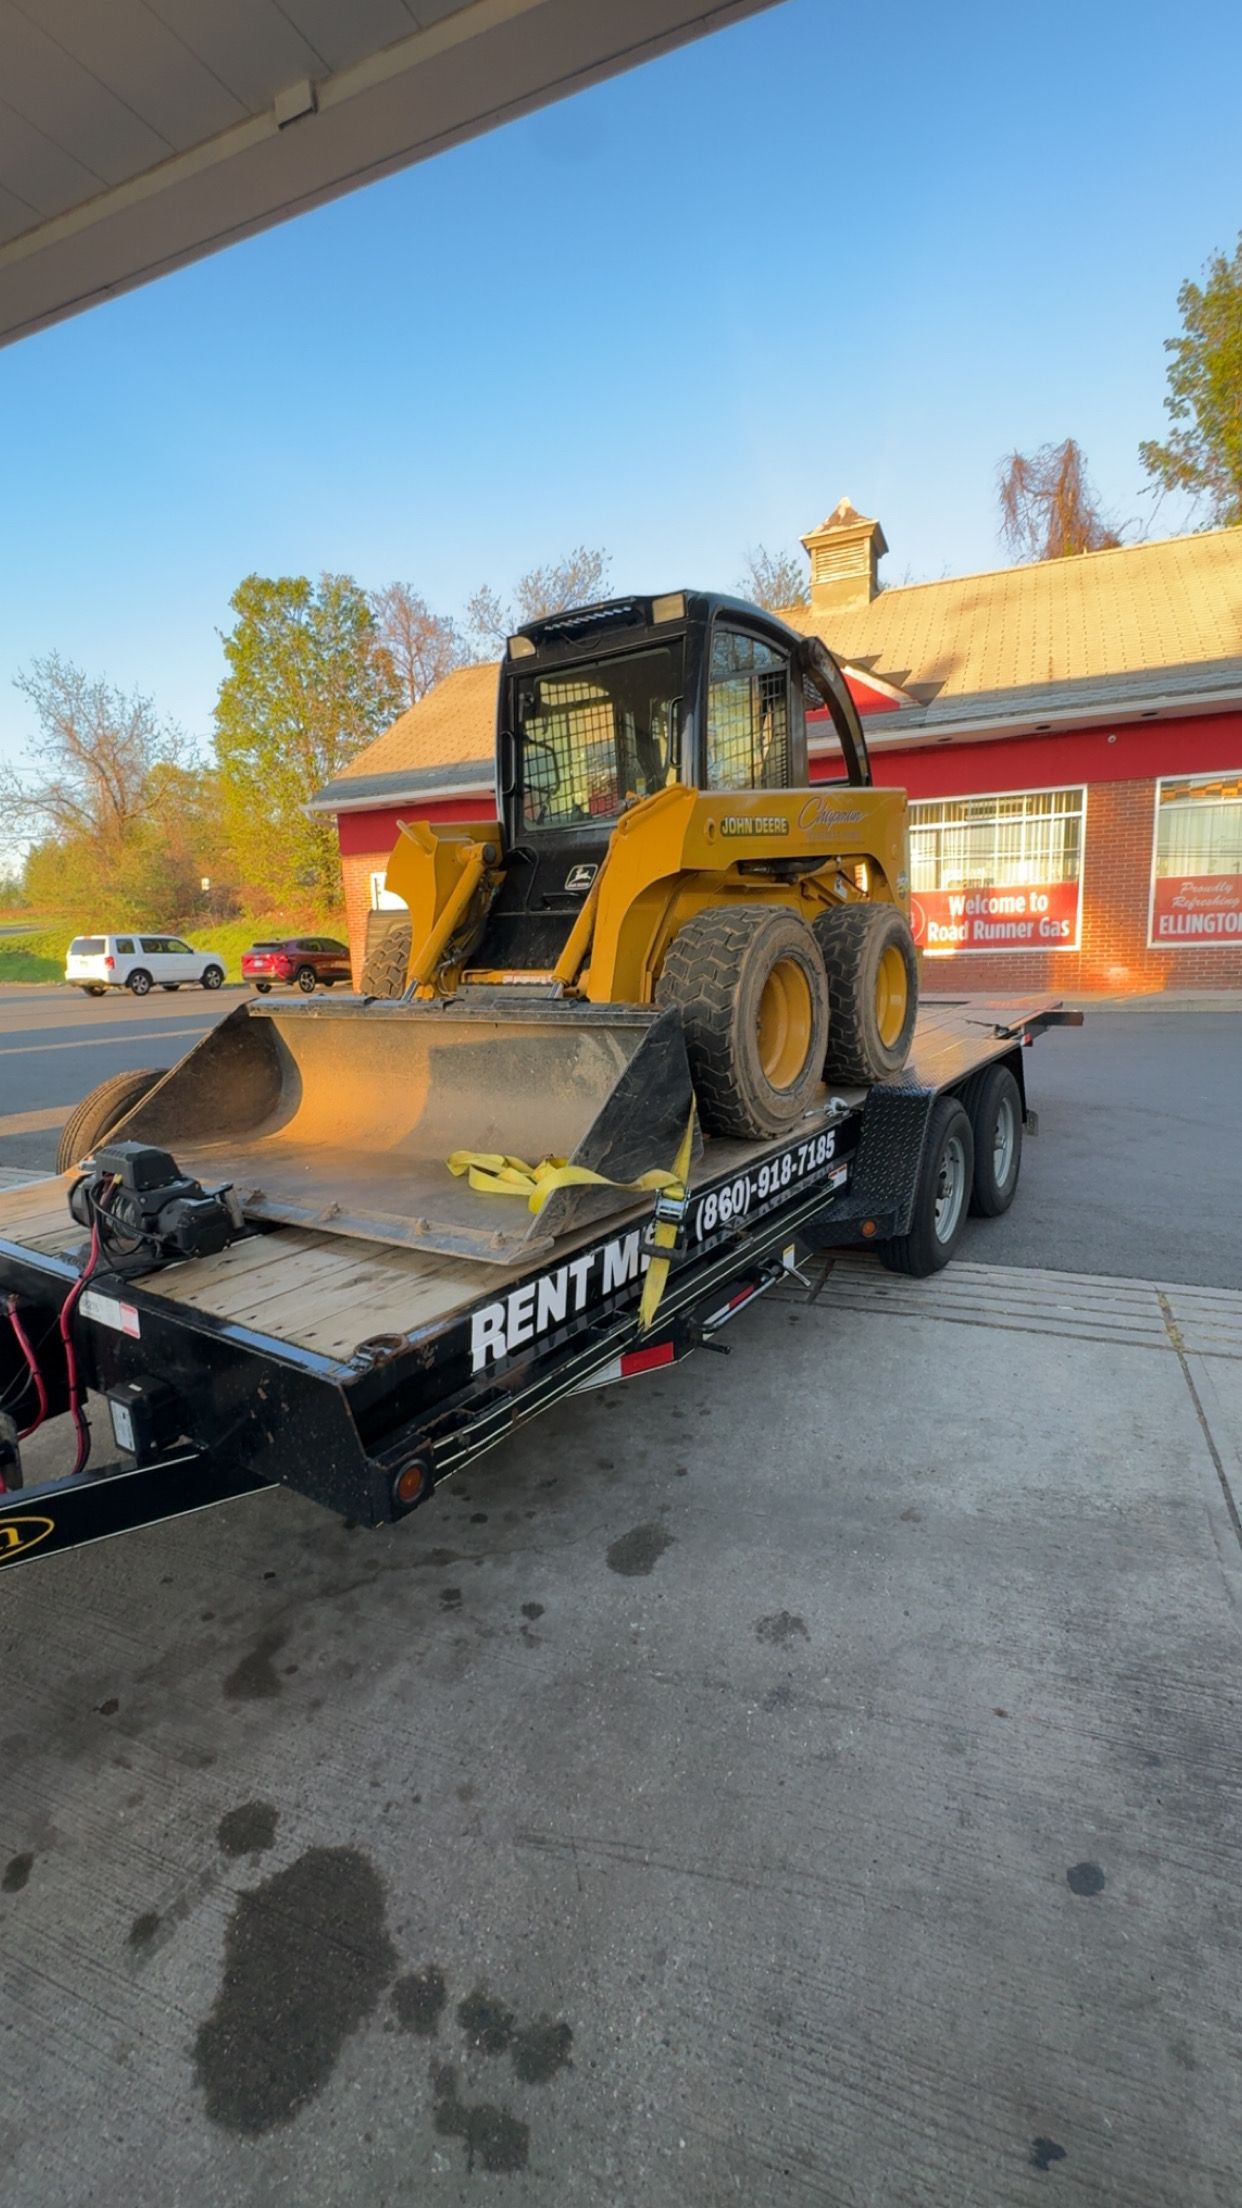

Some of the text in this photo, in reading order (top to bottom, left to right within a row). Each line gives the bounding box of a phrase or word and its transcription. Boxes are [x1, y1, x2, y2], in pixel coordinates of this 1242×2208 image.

[723, 816, 787, 833] JOHN DEERE
[1181, 881, 1233, 894] Proudly
[948, 891, 1049, 916] Welcome to
[1171, 895, 1240, 910] Refreshing
[927, 919, 970, 942] Road
[973, 920, 1034, 940] Runner
[1039, 917, 1070, 937] Gas
[471, 1254, 595, 1373] RENT
[695, 1130, 836, 1242] (860)-918-7185
